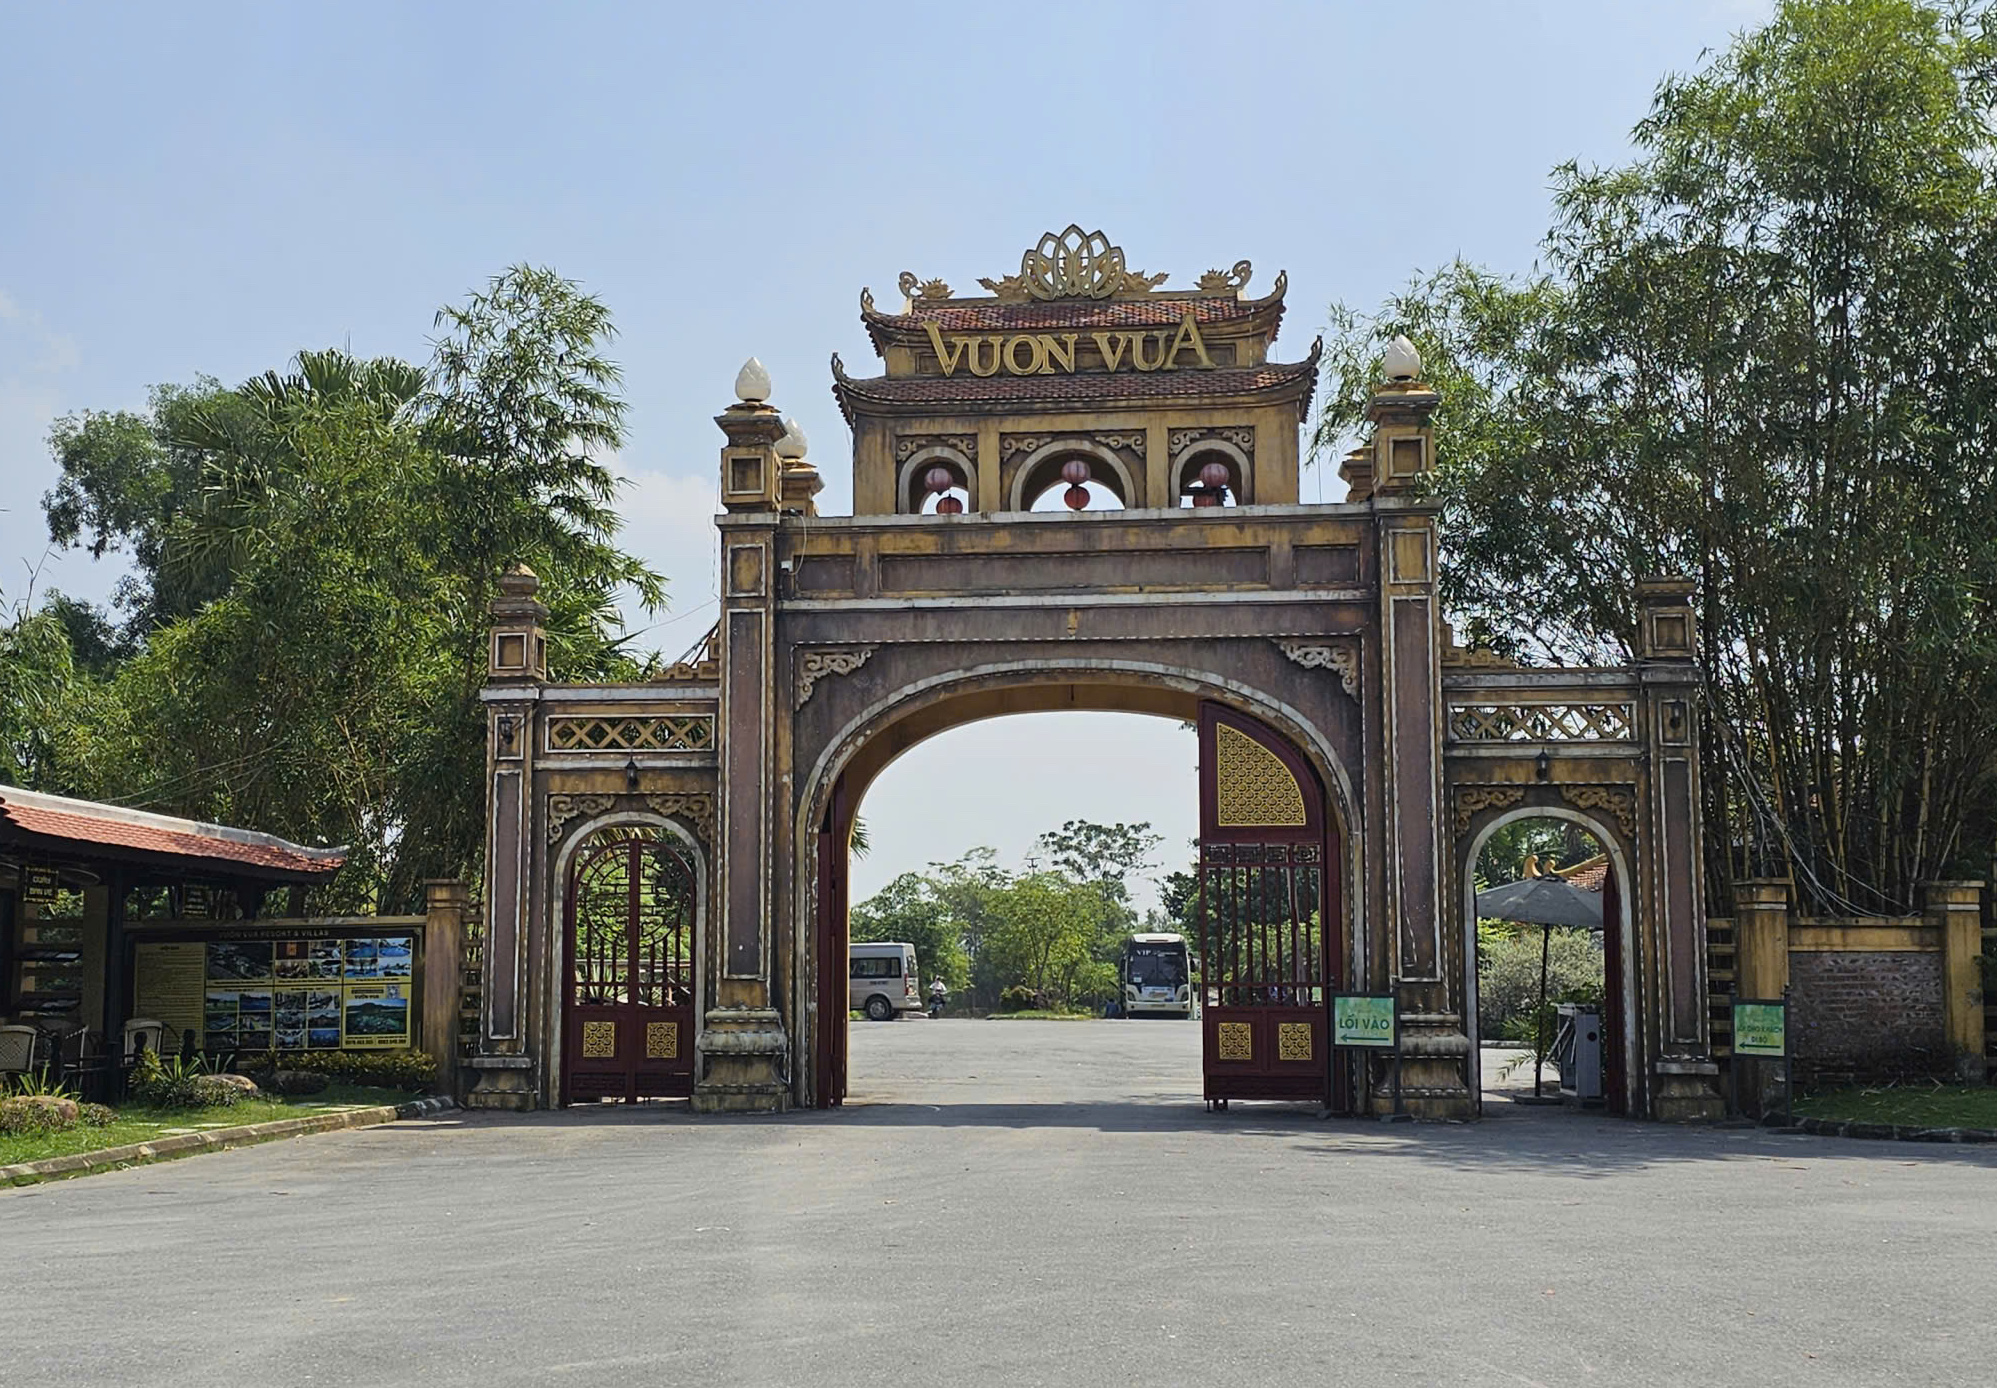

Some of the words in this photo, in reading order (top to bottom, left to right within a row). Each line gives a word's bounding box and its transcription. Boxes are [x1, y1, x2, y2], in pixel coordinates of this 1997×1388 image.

[1091, 314, 1217, 372] VUA
[301, 929, 329, 937] VILLAS
[1339, 1014, 1359, 1029] LỐI
[1362, 1015, 1390, 1030] VÀO
